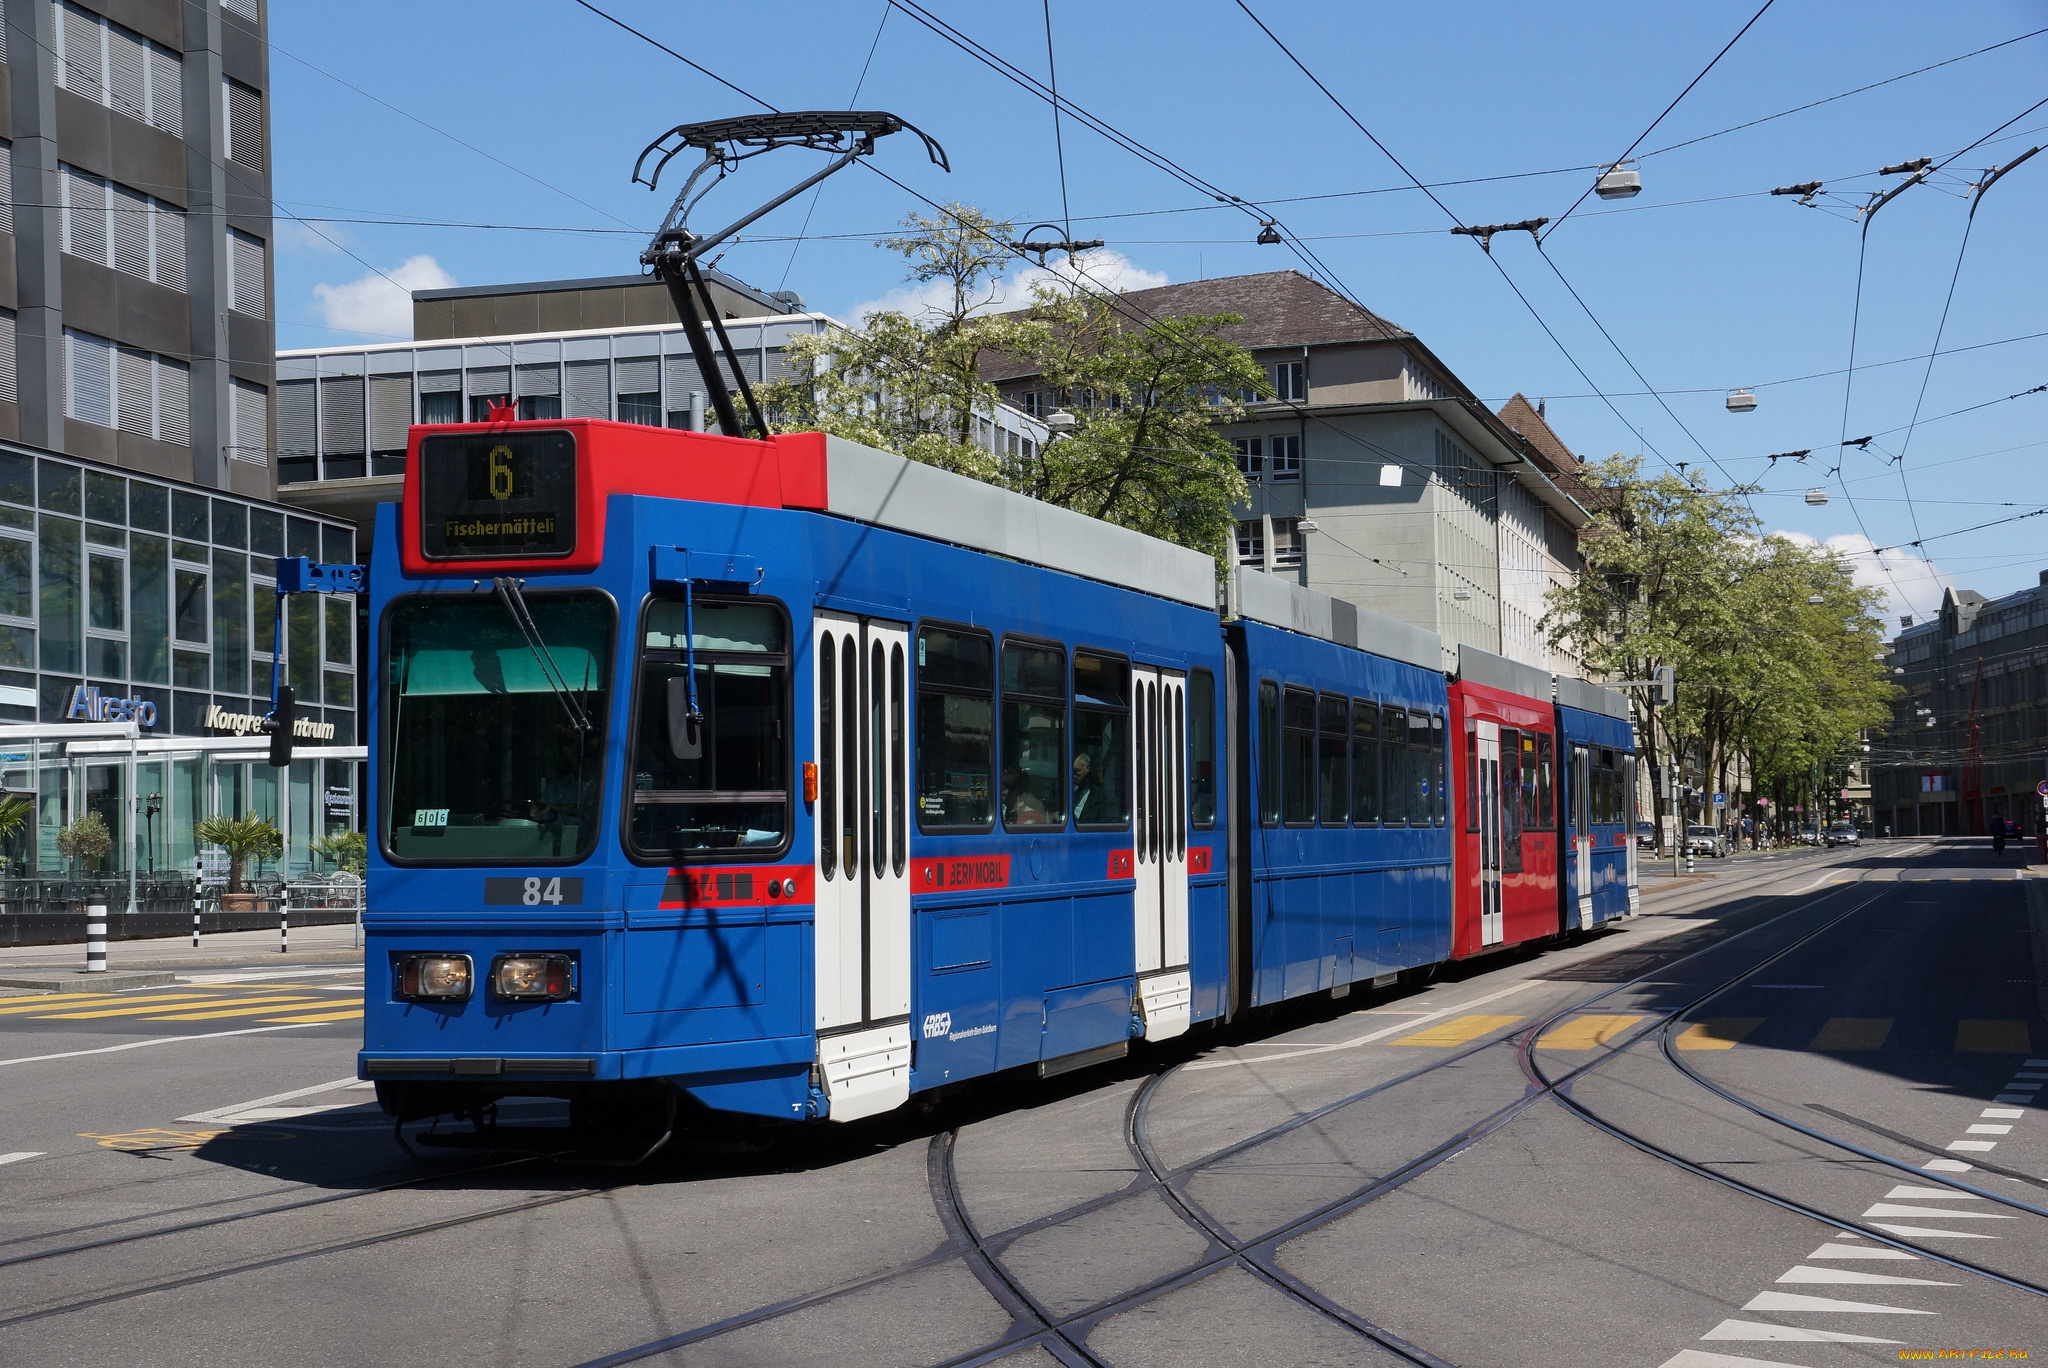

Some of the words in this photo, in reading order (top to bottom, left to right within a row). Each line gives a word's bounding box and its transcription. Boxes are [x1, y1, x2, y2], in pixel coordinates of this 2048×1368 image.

[489, 445, 513, 500] 6
[446, 518, 555, 537] Fischermätteli
[67, 685, 158, 727] Allresto
[204, 704, 335, 740] Kongrentrum
[418, 813, 445, 823] 606
[522, 877, 563, 906] 84
